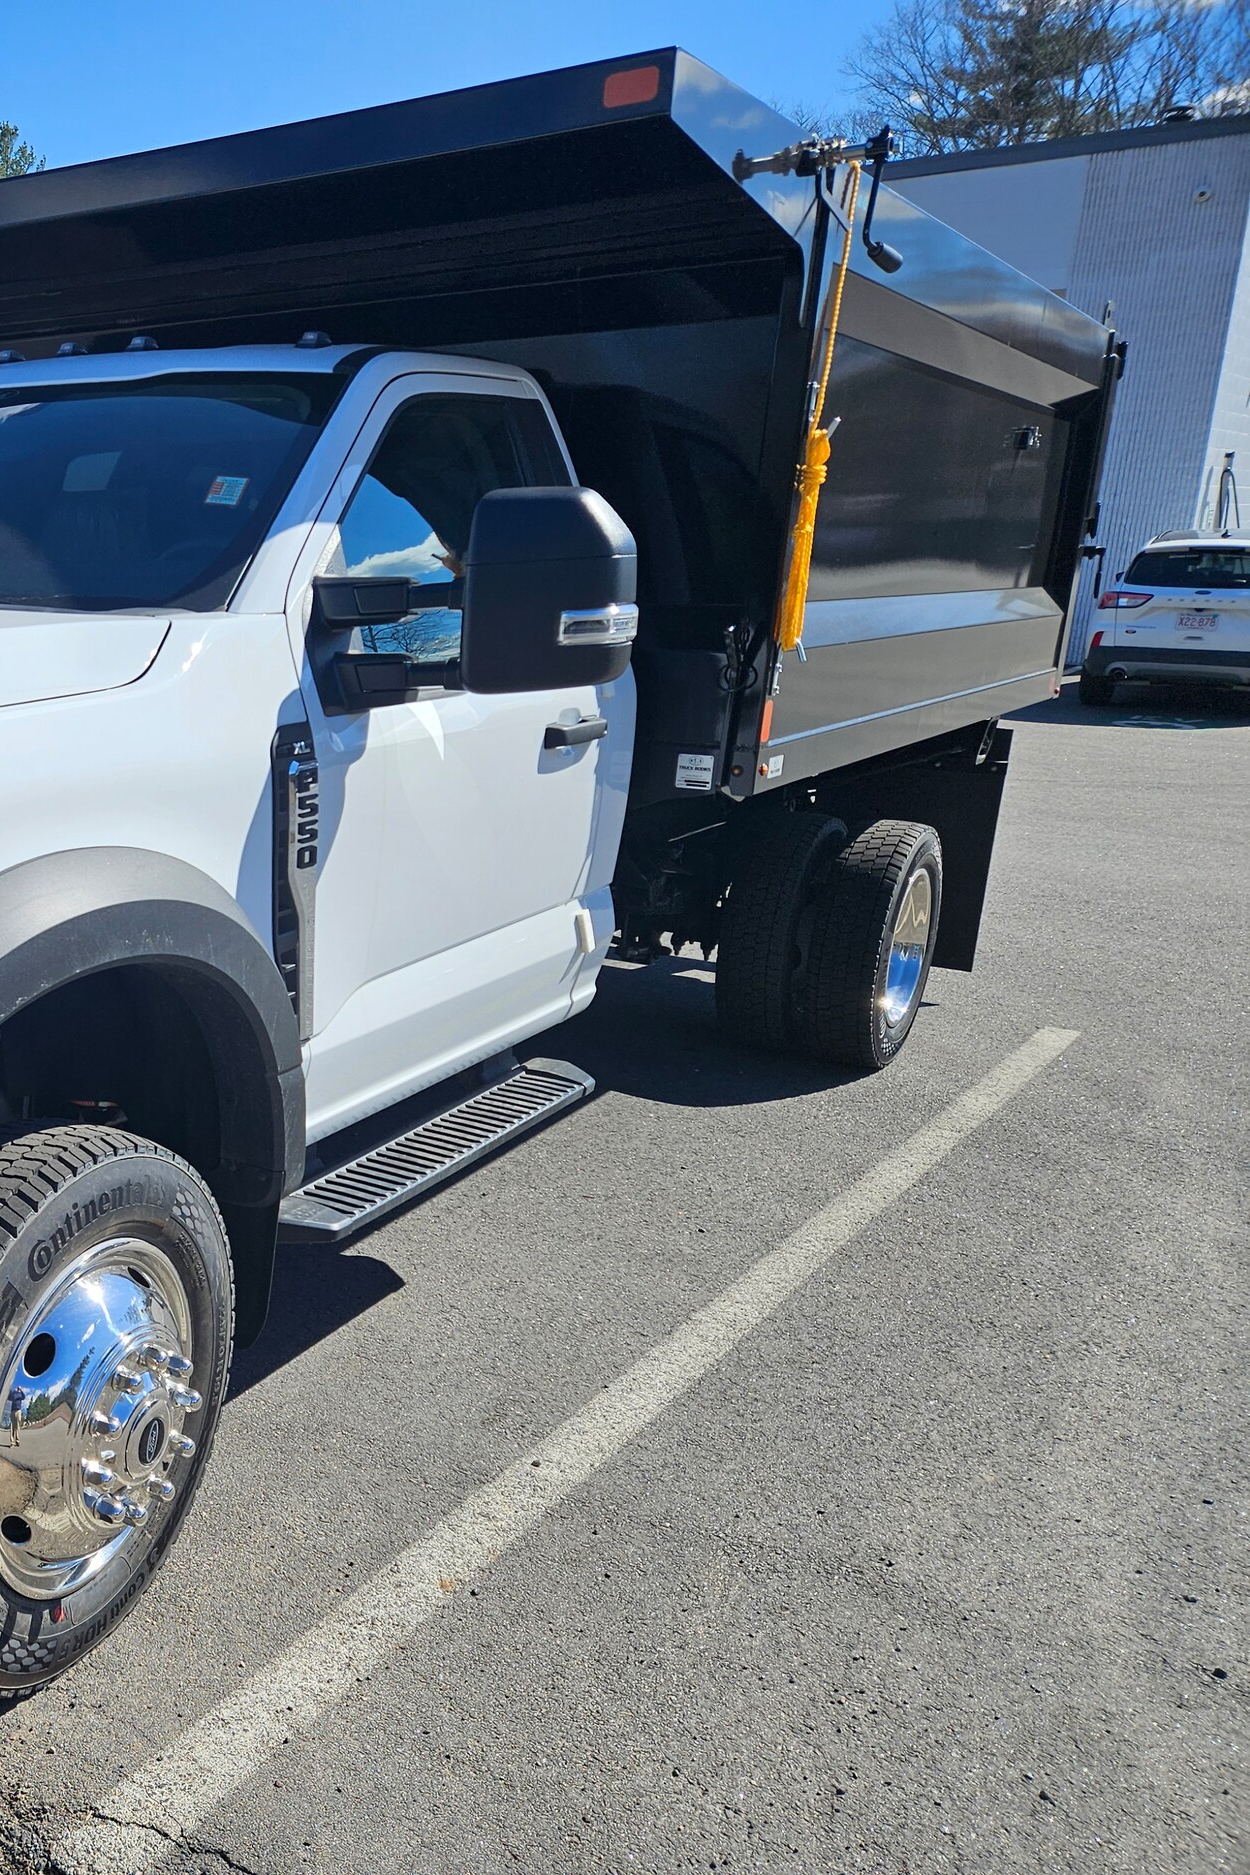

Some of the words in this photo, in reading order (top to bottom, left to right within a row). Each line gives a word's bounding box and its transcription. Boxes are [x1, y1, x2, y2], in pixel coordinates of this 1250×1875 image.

[293, 741, 311, 755] XL
[28, 1175, 155, 1282] Continental
[110, 1572, 145, 1623] Conti
[71, 1613, 108, 1653] HDR
